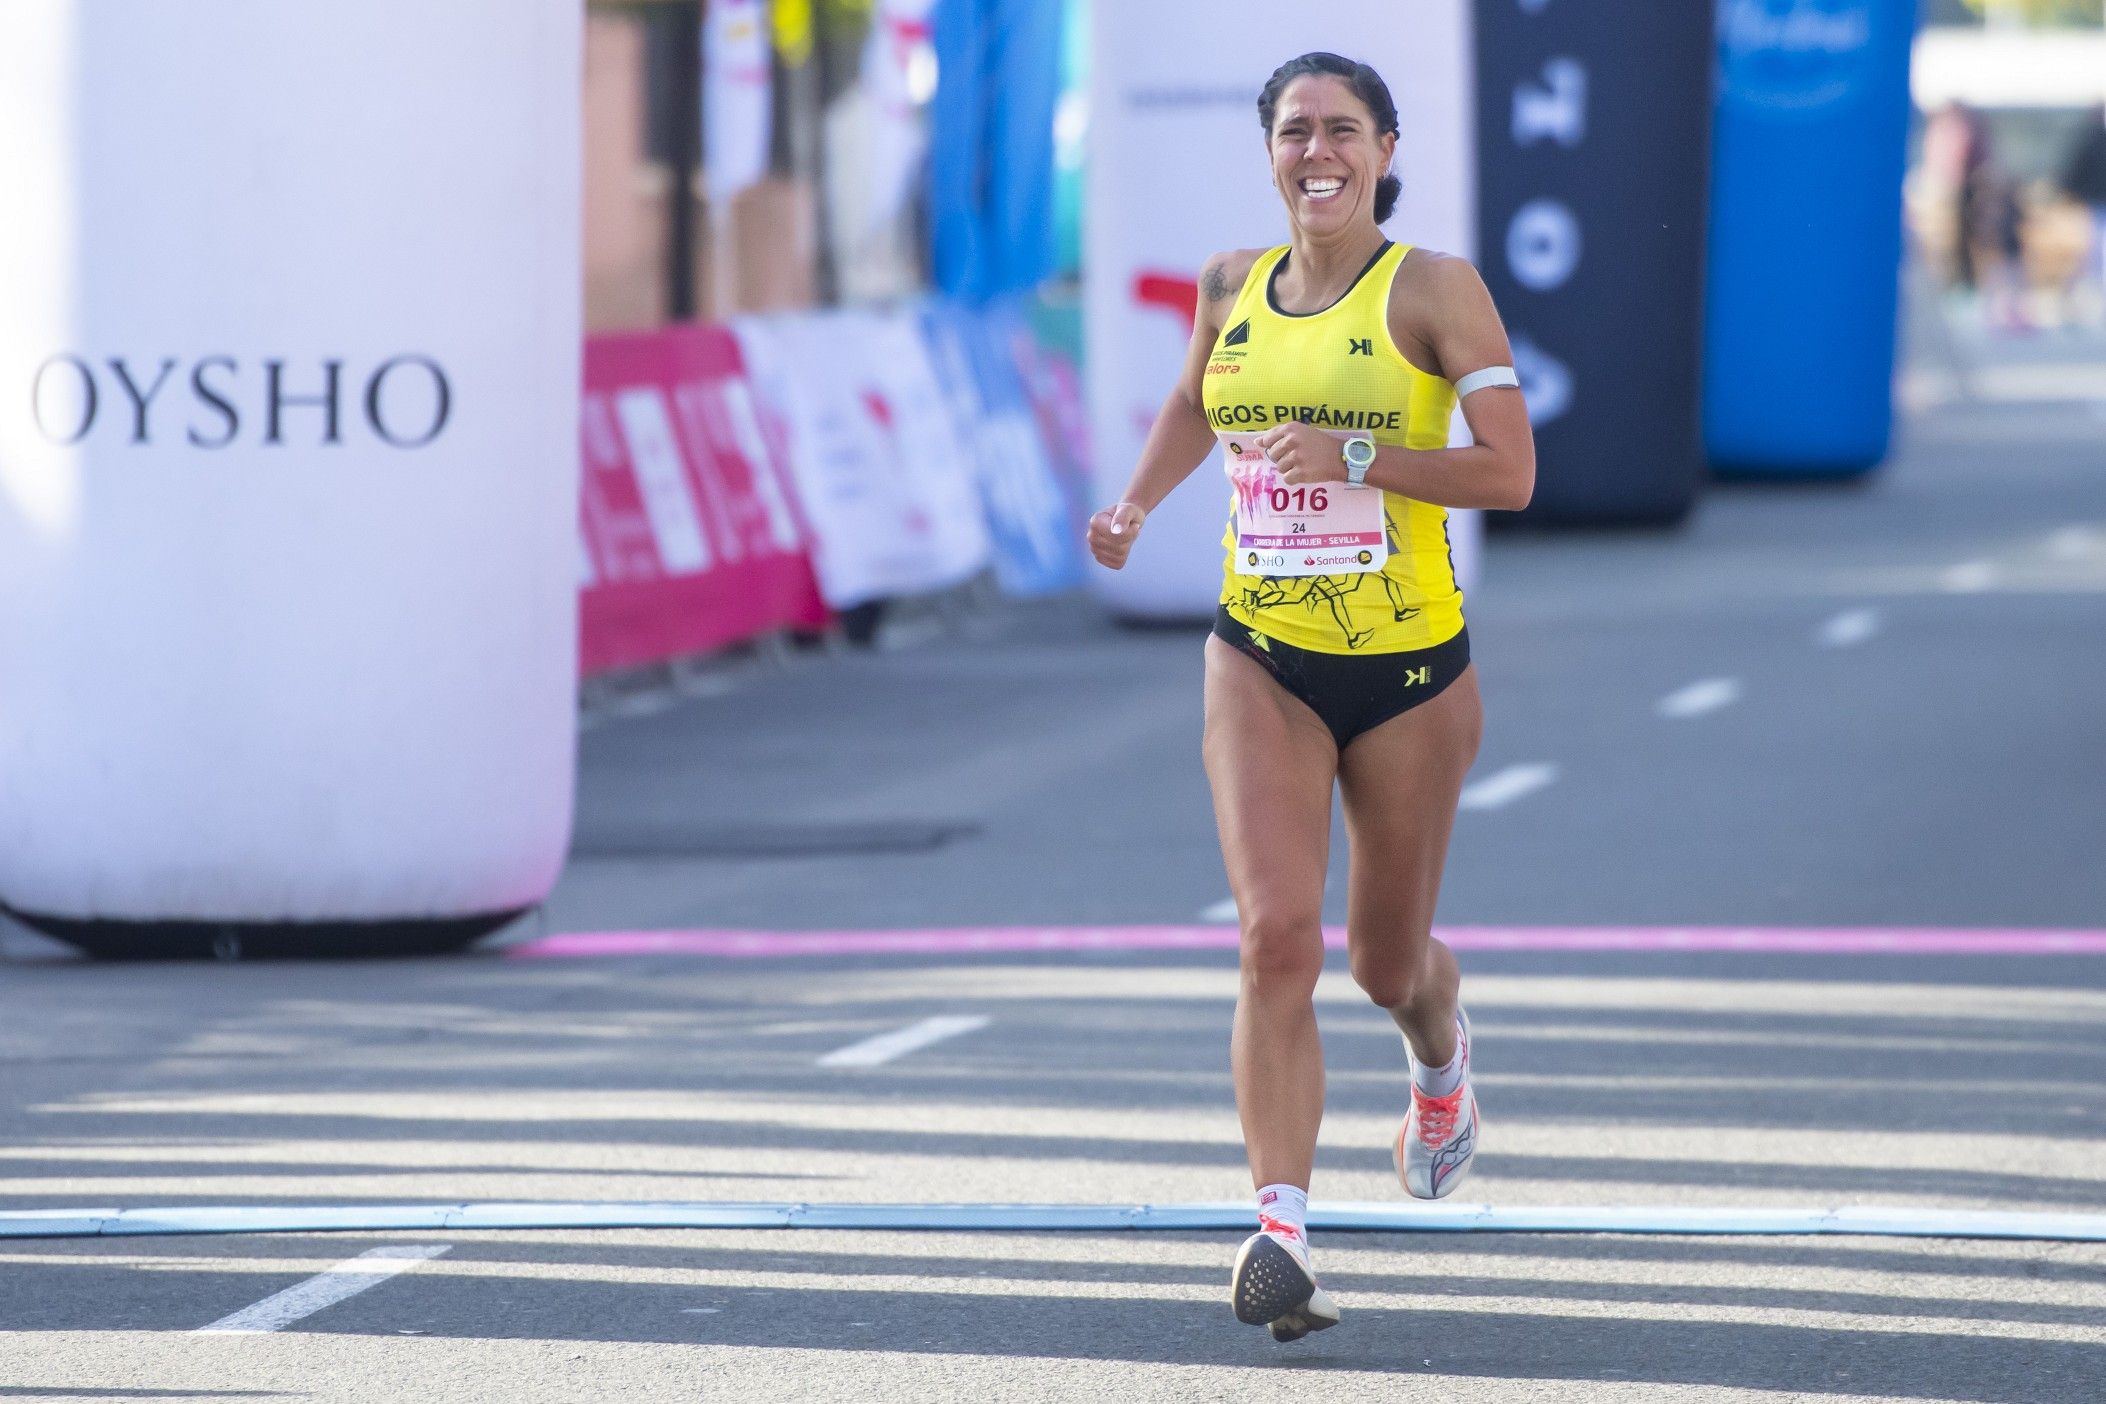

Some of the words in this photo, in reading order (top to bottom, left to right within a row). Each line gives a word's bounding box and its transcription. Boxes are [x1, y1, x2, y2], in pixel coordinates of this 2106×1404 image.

[1503, 0, 1588, 428] VOL
[33, 353, 453, 450] OYSHO
[1207, 405, 1268, 427] IGOS
[1274, 404, 1401, 430] PIRÁMIDE
[1271, 487, 1328, 512] 016
[1285, 538, 1295, 547] LA
[1297, 536, 1322, 547] MUJER
[1328, 535, 1361, 545] SEVILLA
[1292, 523, 1306, 534] 24
[1250, 555, 1284, 567] YSHO
[1316, 555, 1361, 566] Santand
